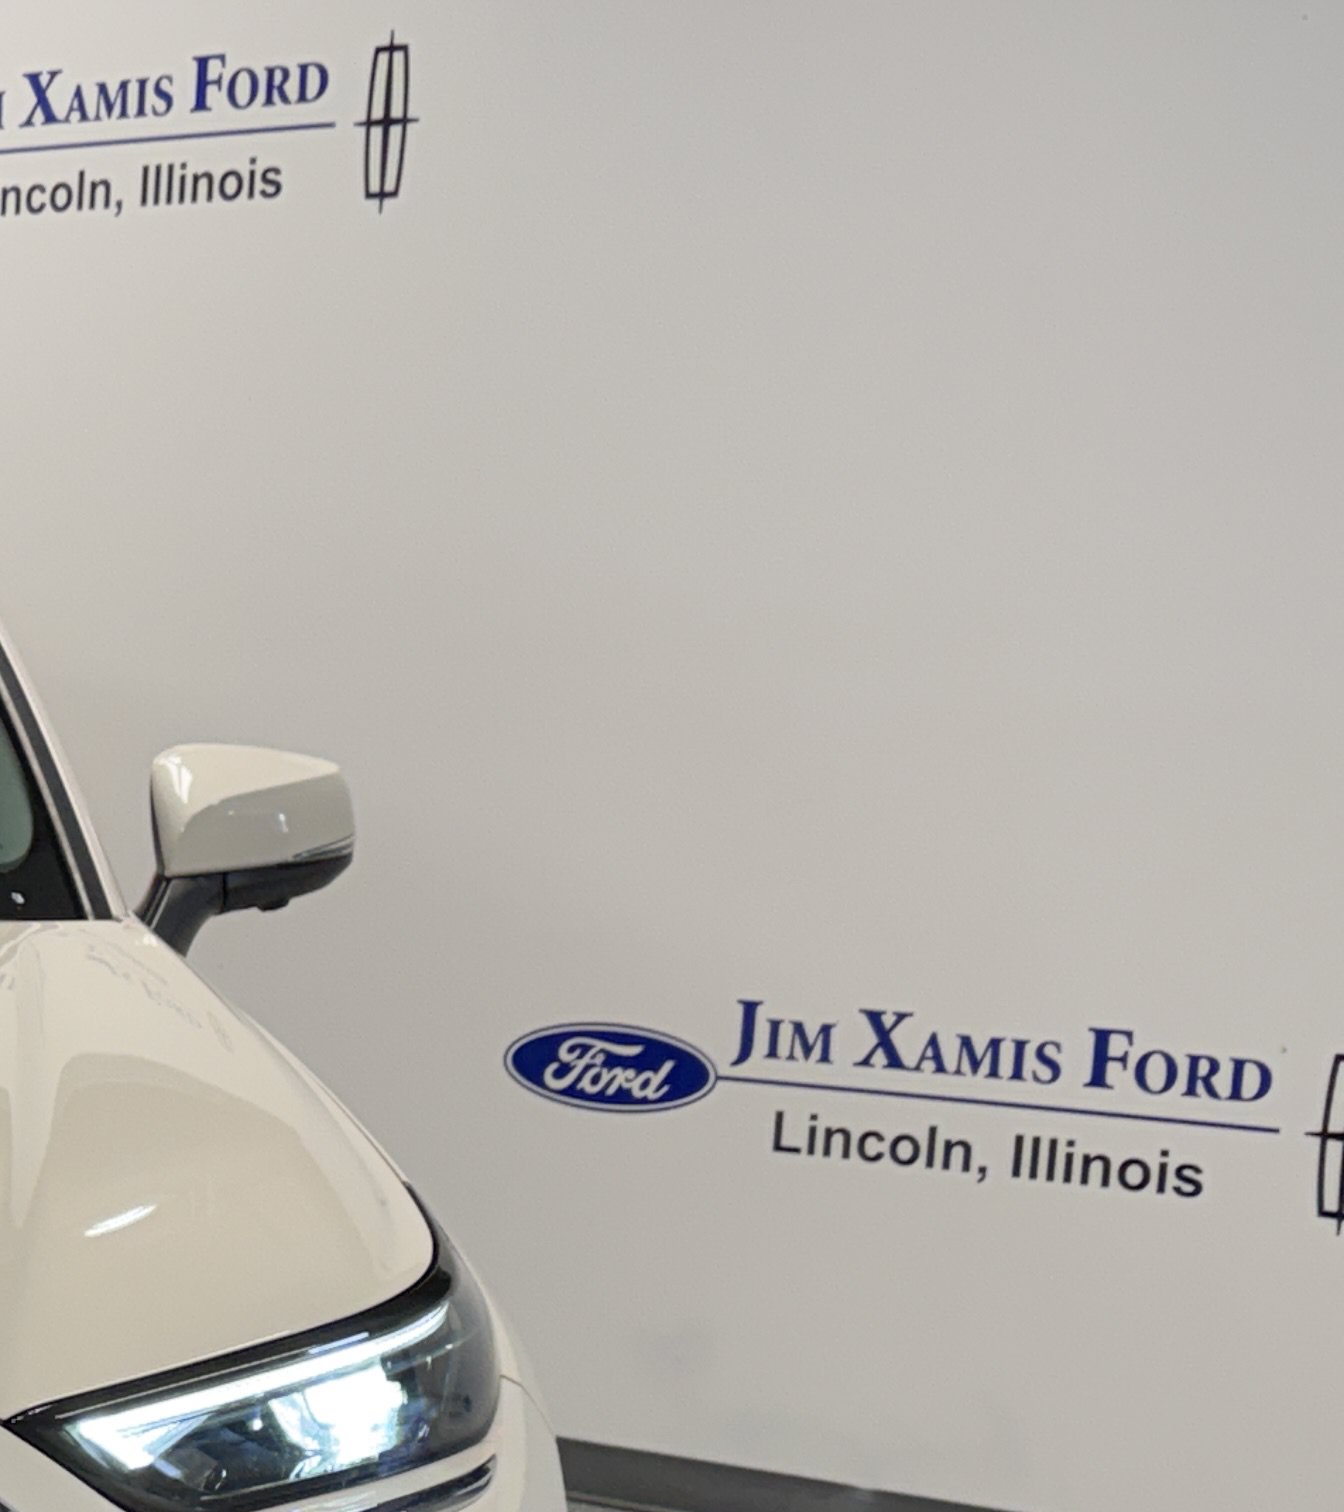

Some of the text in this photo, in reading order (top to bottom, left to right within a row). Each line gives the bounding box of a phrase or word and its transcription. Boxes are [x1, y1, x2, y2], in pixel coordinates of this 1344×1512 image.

[19, 69, 174, 129] XAMIS
[189, 54, 329, 114] FORD
[140, 158, 282, 207] Illinois
[543, 1036, 670, 1102] Ford
[731, 999, 1273, 1104] JIM XAMIS FORD
[772, 1111, 1205, 1197] Lincoln, Illinois
